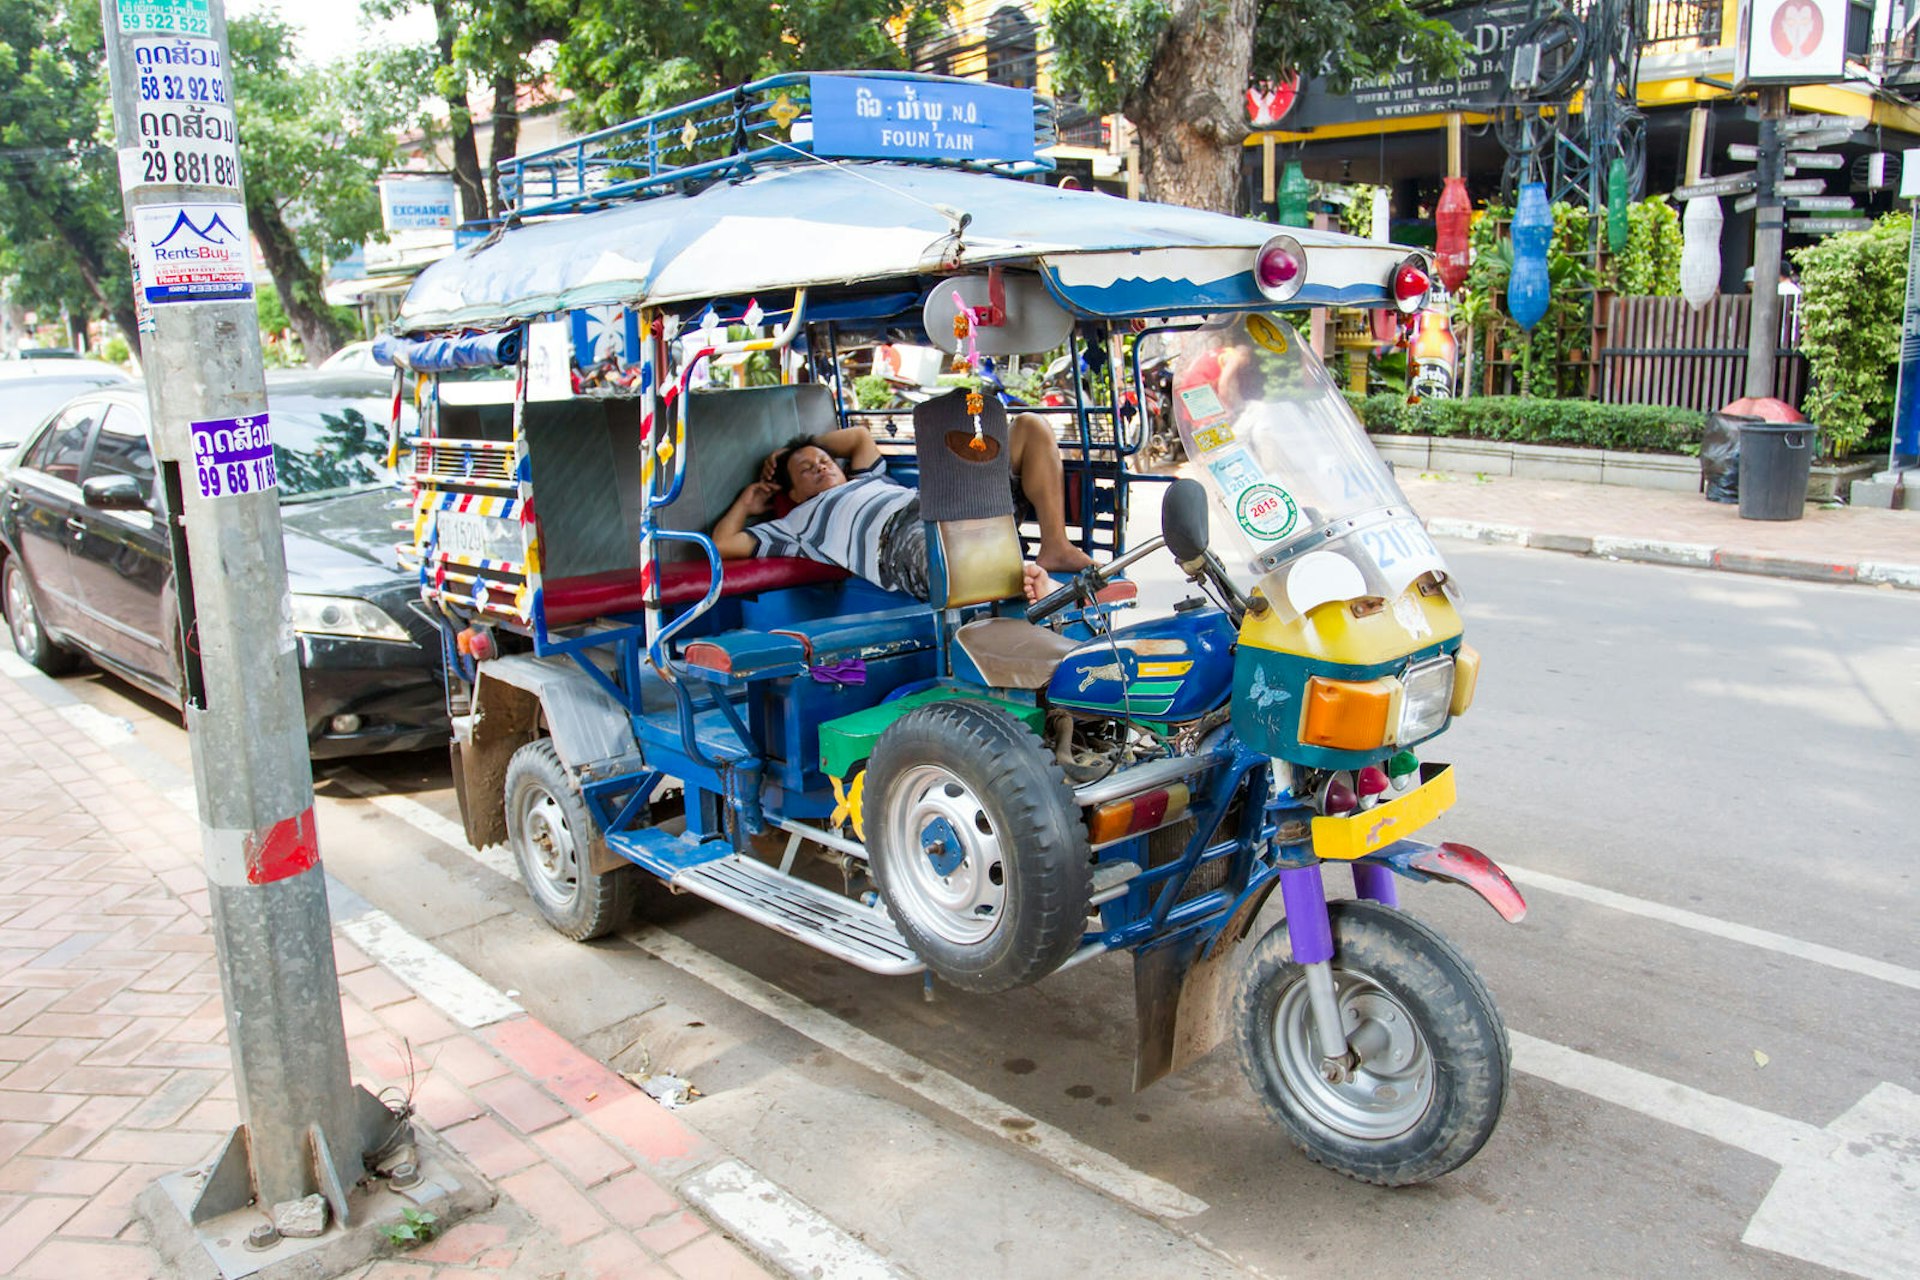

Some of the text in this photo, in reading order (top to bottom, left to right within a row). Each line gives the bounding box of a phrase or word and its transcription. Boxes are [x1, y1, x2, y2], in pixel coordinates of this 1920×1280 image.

[123, 14, 208, 34] 59 522 522
[141, 76, 160, 101] 58
[163, 75, 185, 100] 32
[188, 76, 209, 101] 92
[1394, 90, 1414, 100] THE
[1417, 85, 1454, 97] WORLD
[142, 151, 237, 187] 29 881 881
[393, 205, 451, 216] EXCHANGE
[155, 246, 229, 261] RentsBuy
[191, 273, 211, 284] Buy
[198, 466, 222, 497] 99
[227, 462, 249, 494] 68
[1250, 497, 1278, 518] 2015
